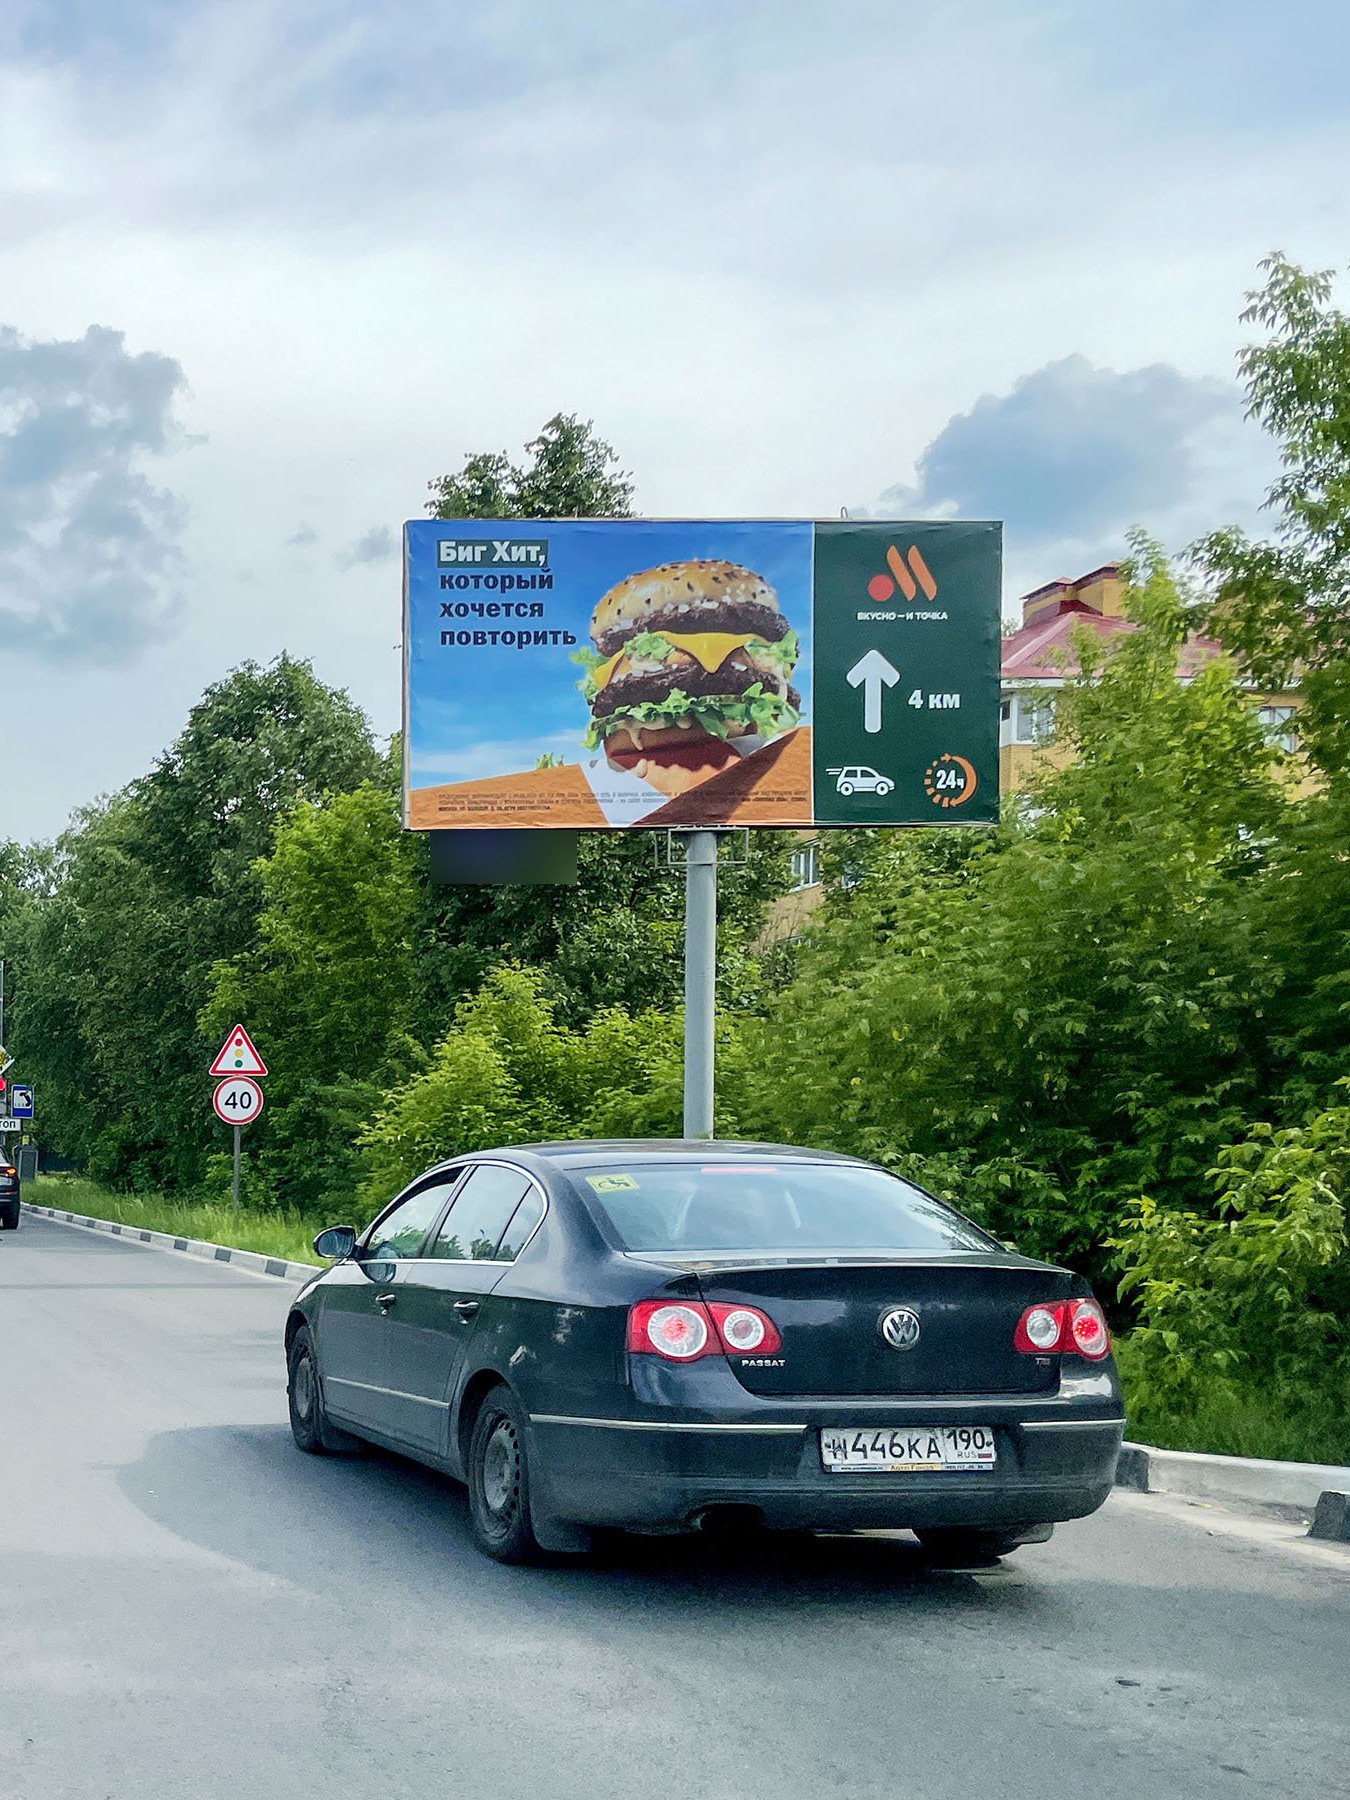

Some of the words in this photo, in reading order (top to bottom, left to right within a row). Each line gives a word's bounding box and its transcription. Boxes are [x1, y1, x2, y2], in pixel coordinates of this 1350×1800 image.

[439, 541, 487, 562] Биг
[492, 541, 546, 567] Хит,
[440, 568, 554, 594] который
[439, 602, 544, 618] хочется
[857, 612, 896, 621] ВКУСНО
[914, 612, 948, 620] ТОЧКА
[440, 630, 577, 650] повторить
[908, 689, 924, 709] 4
[224, 1091, 252, 1109] 40
[741, 1359, 786, 1367] PASSAT
[957, 1450, 978, 1459] RUS
